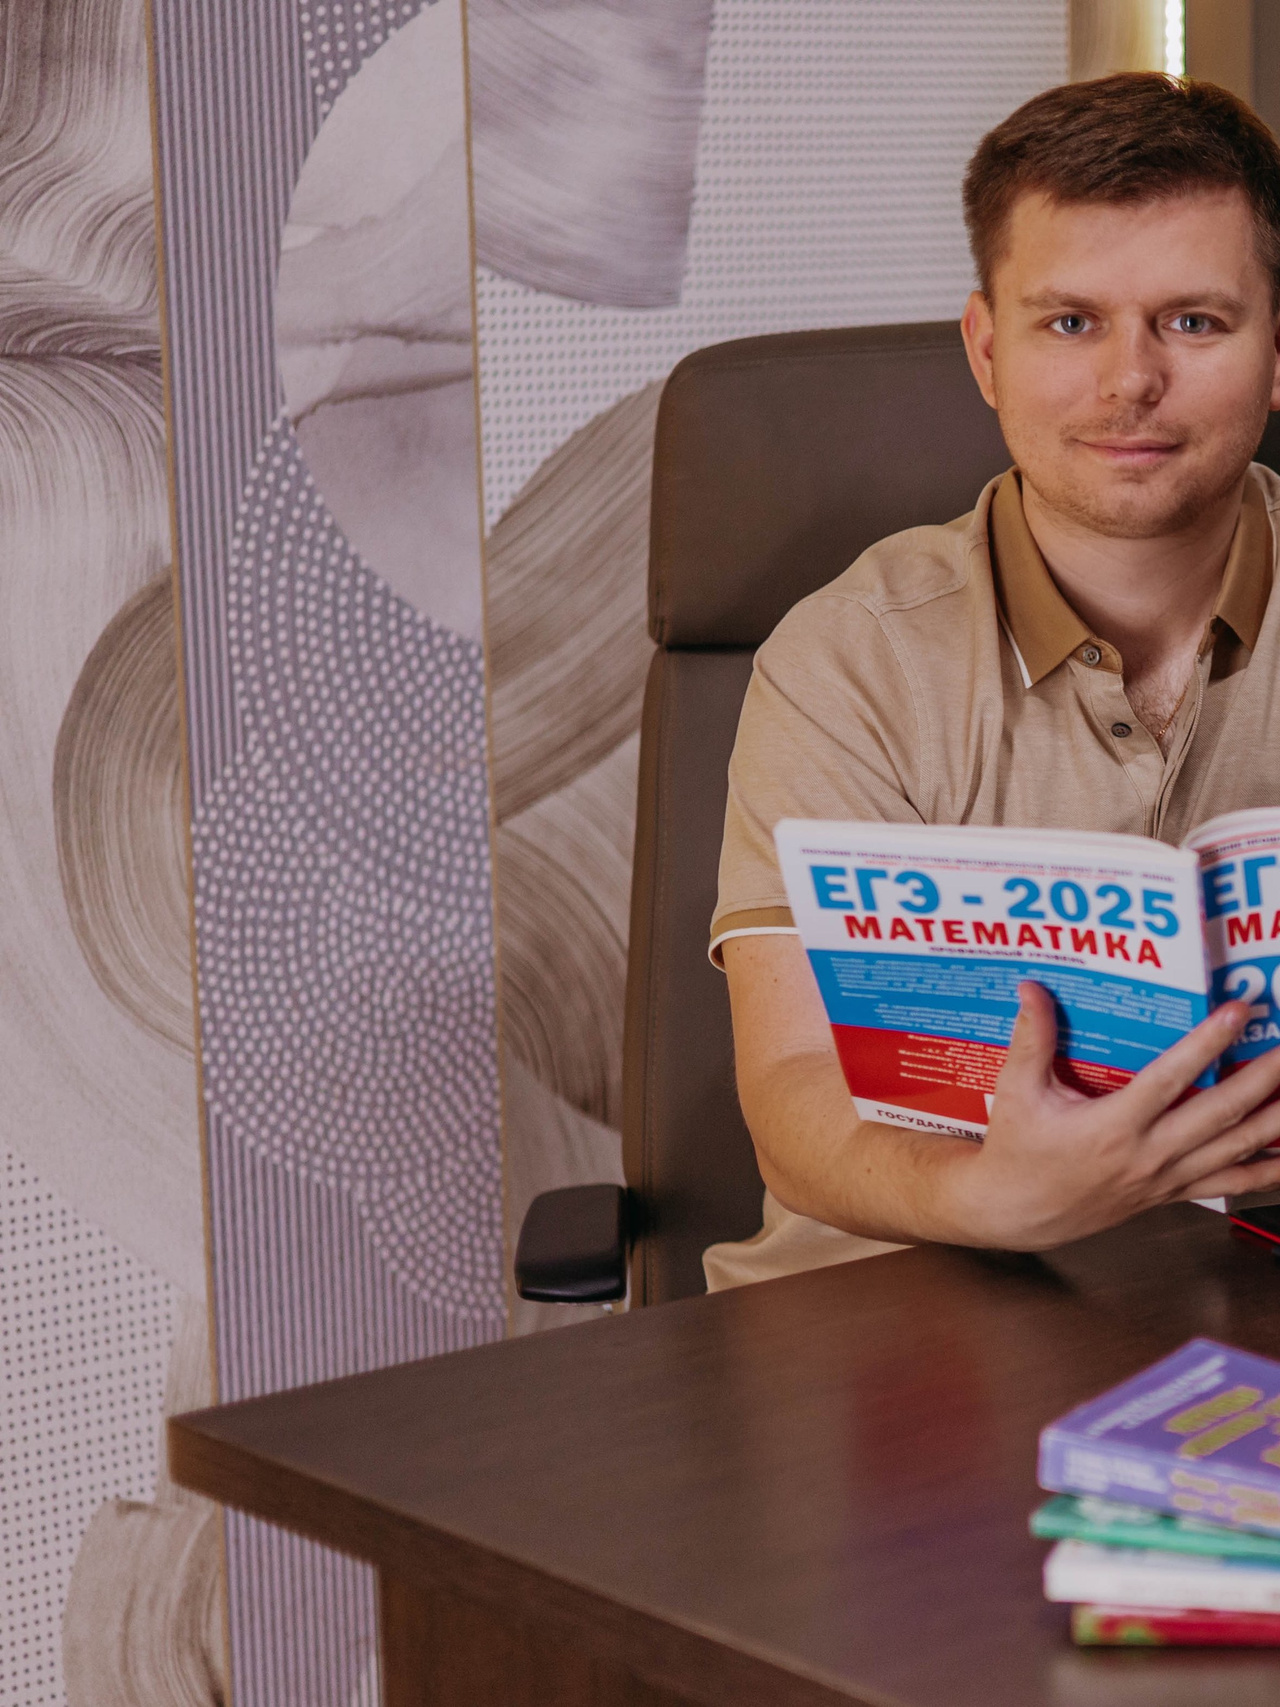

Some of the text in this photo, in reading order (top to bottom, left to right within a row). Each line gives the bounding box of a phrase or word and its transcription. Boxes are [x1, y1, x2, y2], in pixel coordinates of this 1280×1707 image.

[809, 865, 1179, 938] ЕГЭ - 2025
[844, 915, 1163, 969] МАТЕМАТИКА
[876, 1109, 986, 1140] ГОСУДАРСТВЕ
